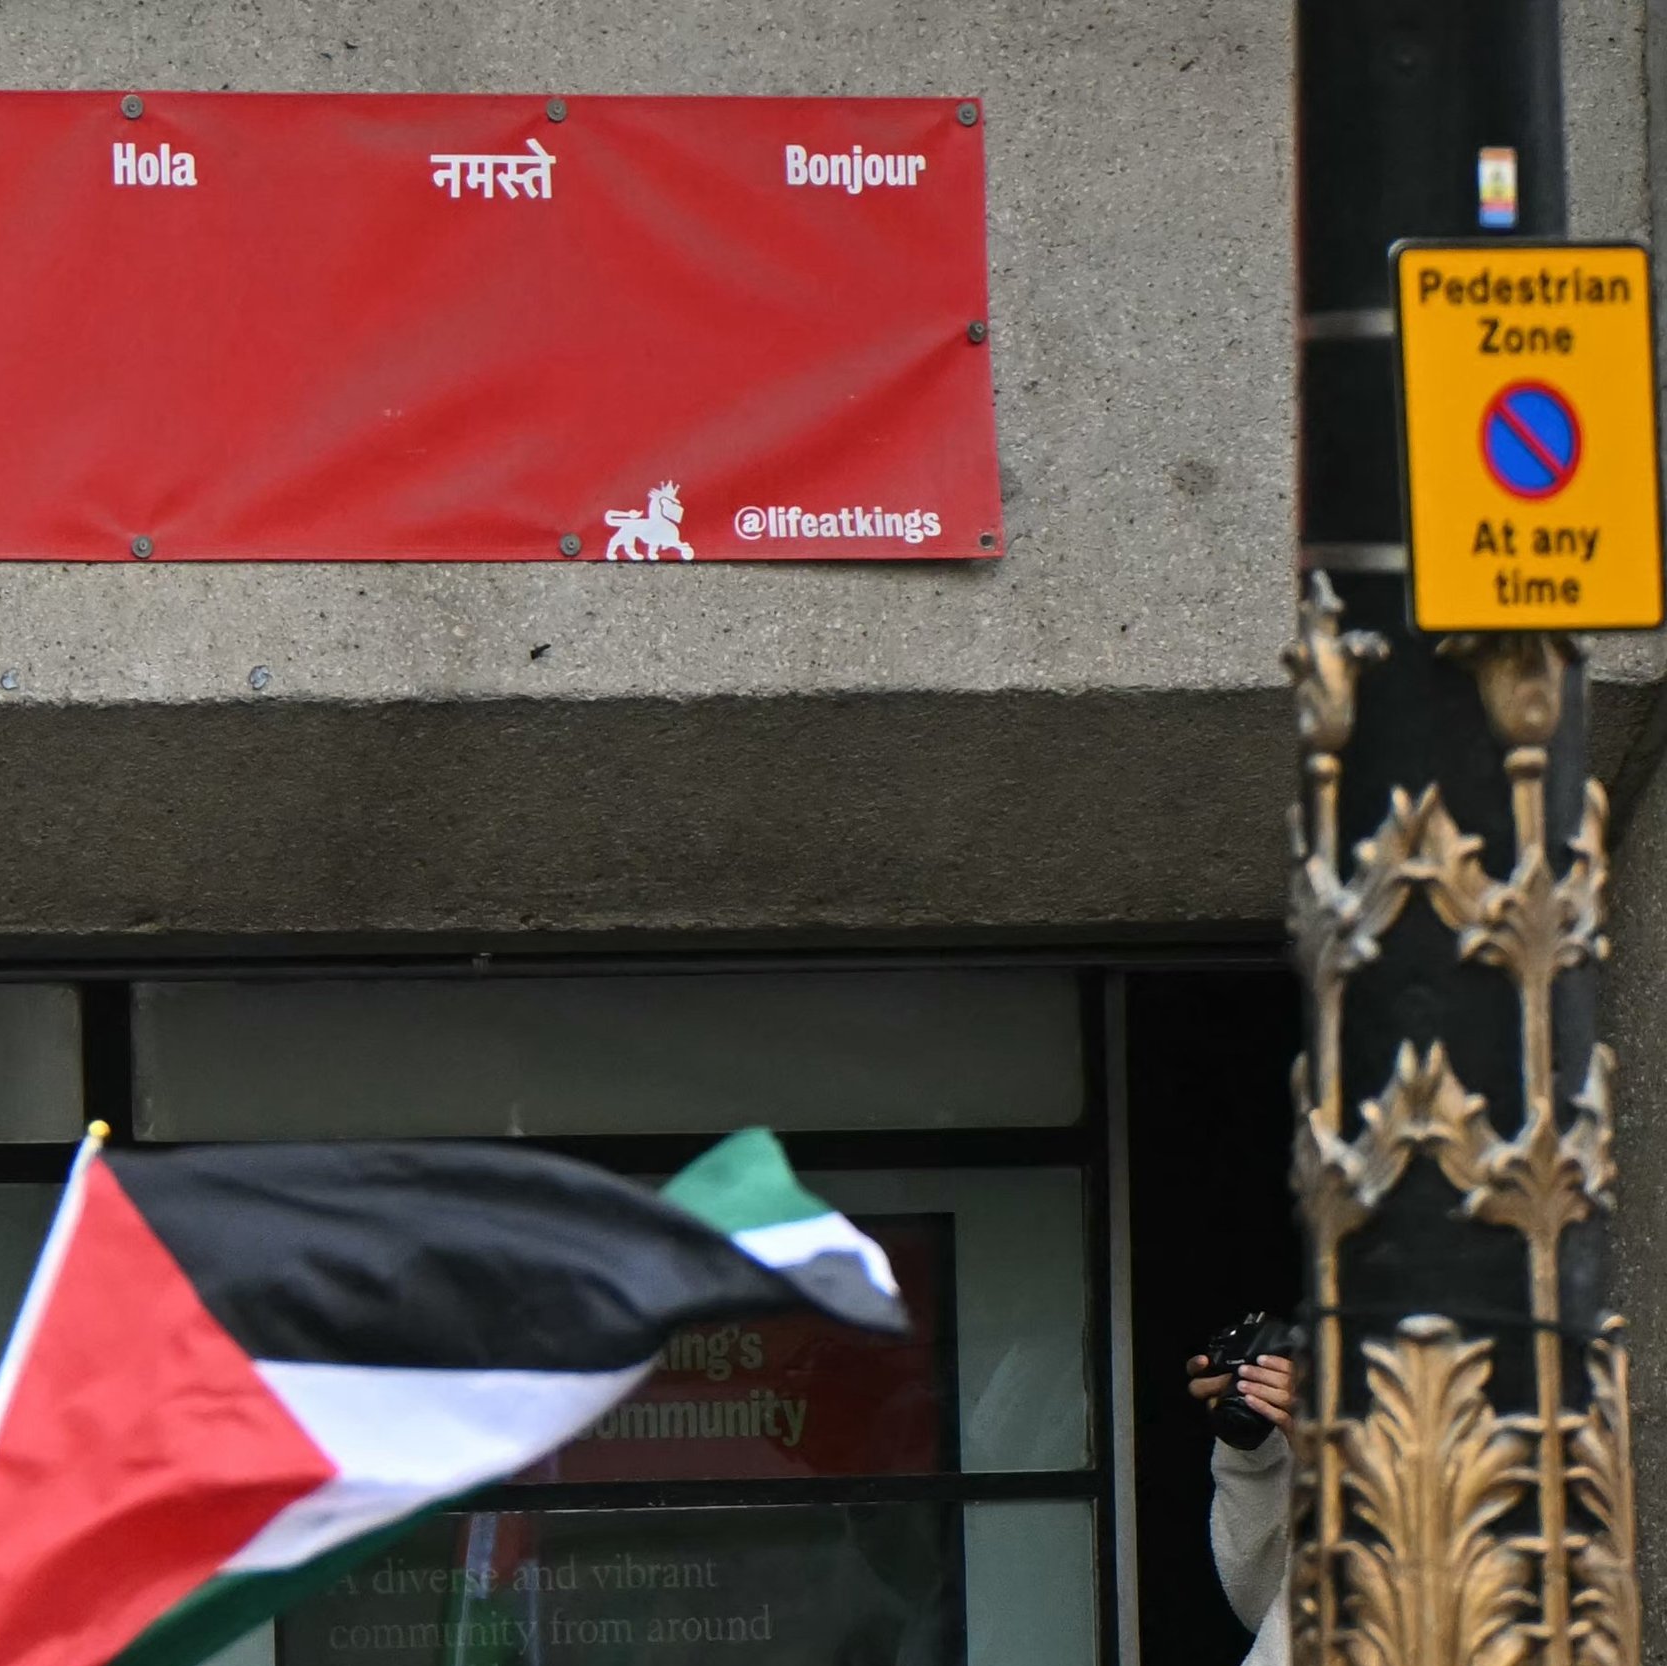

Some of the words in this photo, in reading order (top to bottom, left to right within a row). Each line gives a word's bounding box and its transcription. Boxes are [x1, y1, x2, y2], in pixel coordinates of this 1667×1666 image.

[113, 142, 198, 187] Hola
[430, 138, 557, 200] नमस्ते
[785, 144, 926, 195] Bonjour
[1418, 269, 1630, 305] Pedestrian
[1479, 318, 1574, 355] Zone
[734, 505, 942, 544] @lifeatkings
[1473, 520, 1516, 556] At
[1533, 524, 1600, 561] any
[1494, 570, 1580, 606] time
[657, 1323, 763, 1382] ing's
[576, 1388, 808, 1447] ommunity
[372, 1557, 500, 1595] diverse
[512, 1553, 577, 1592] and
[590, 1552, 719, 1591] vibrant
[328, 1610, 539, 1655] community
[549, 1607, 633, 1645] from
[646, 1603, 773, 1643] around
